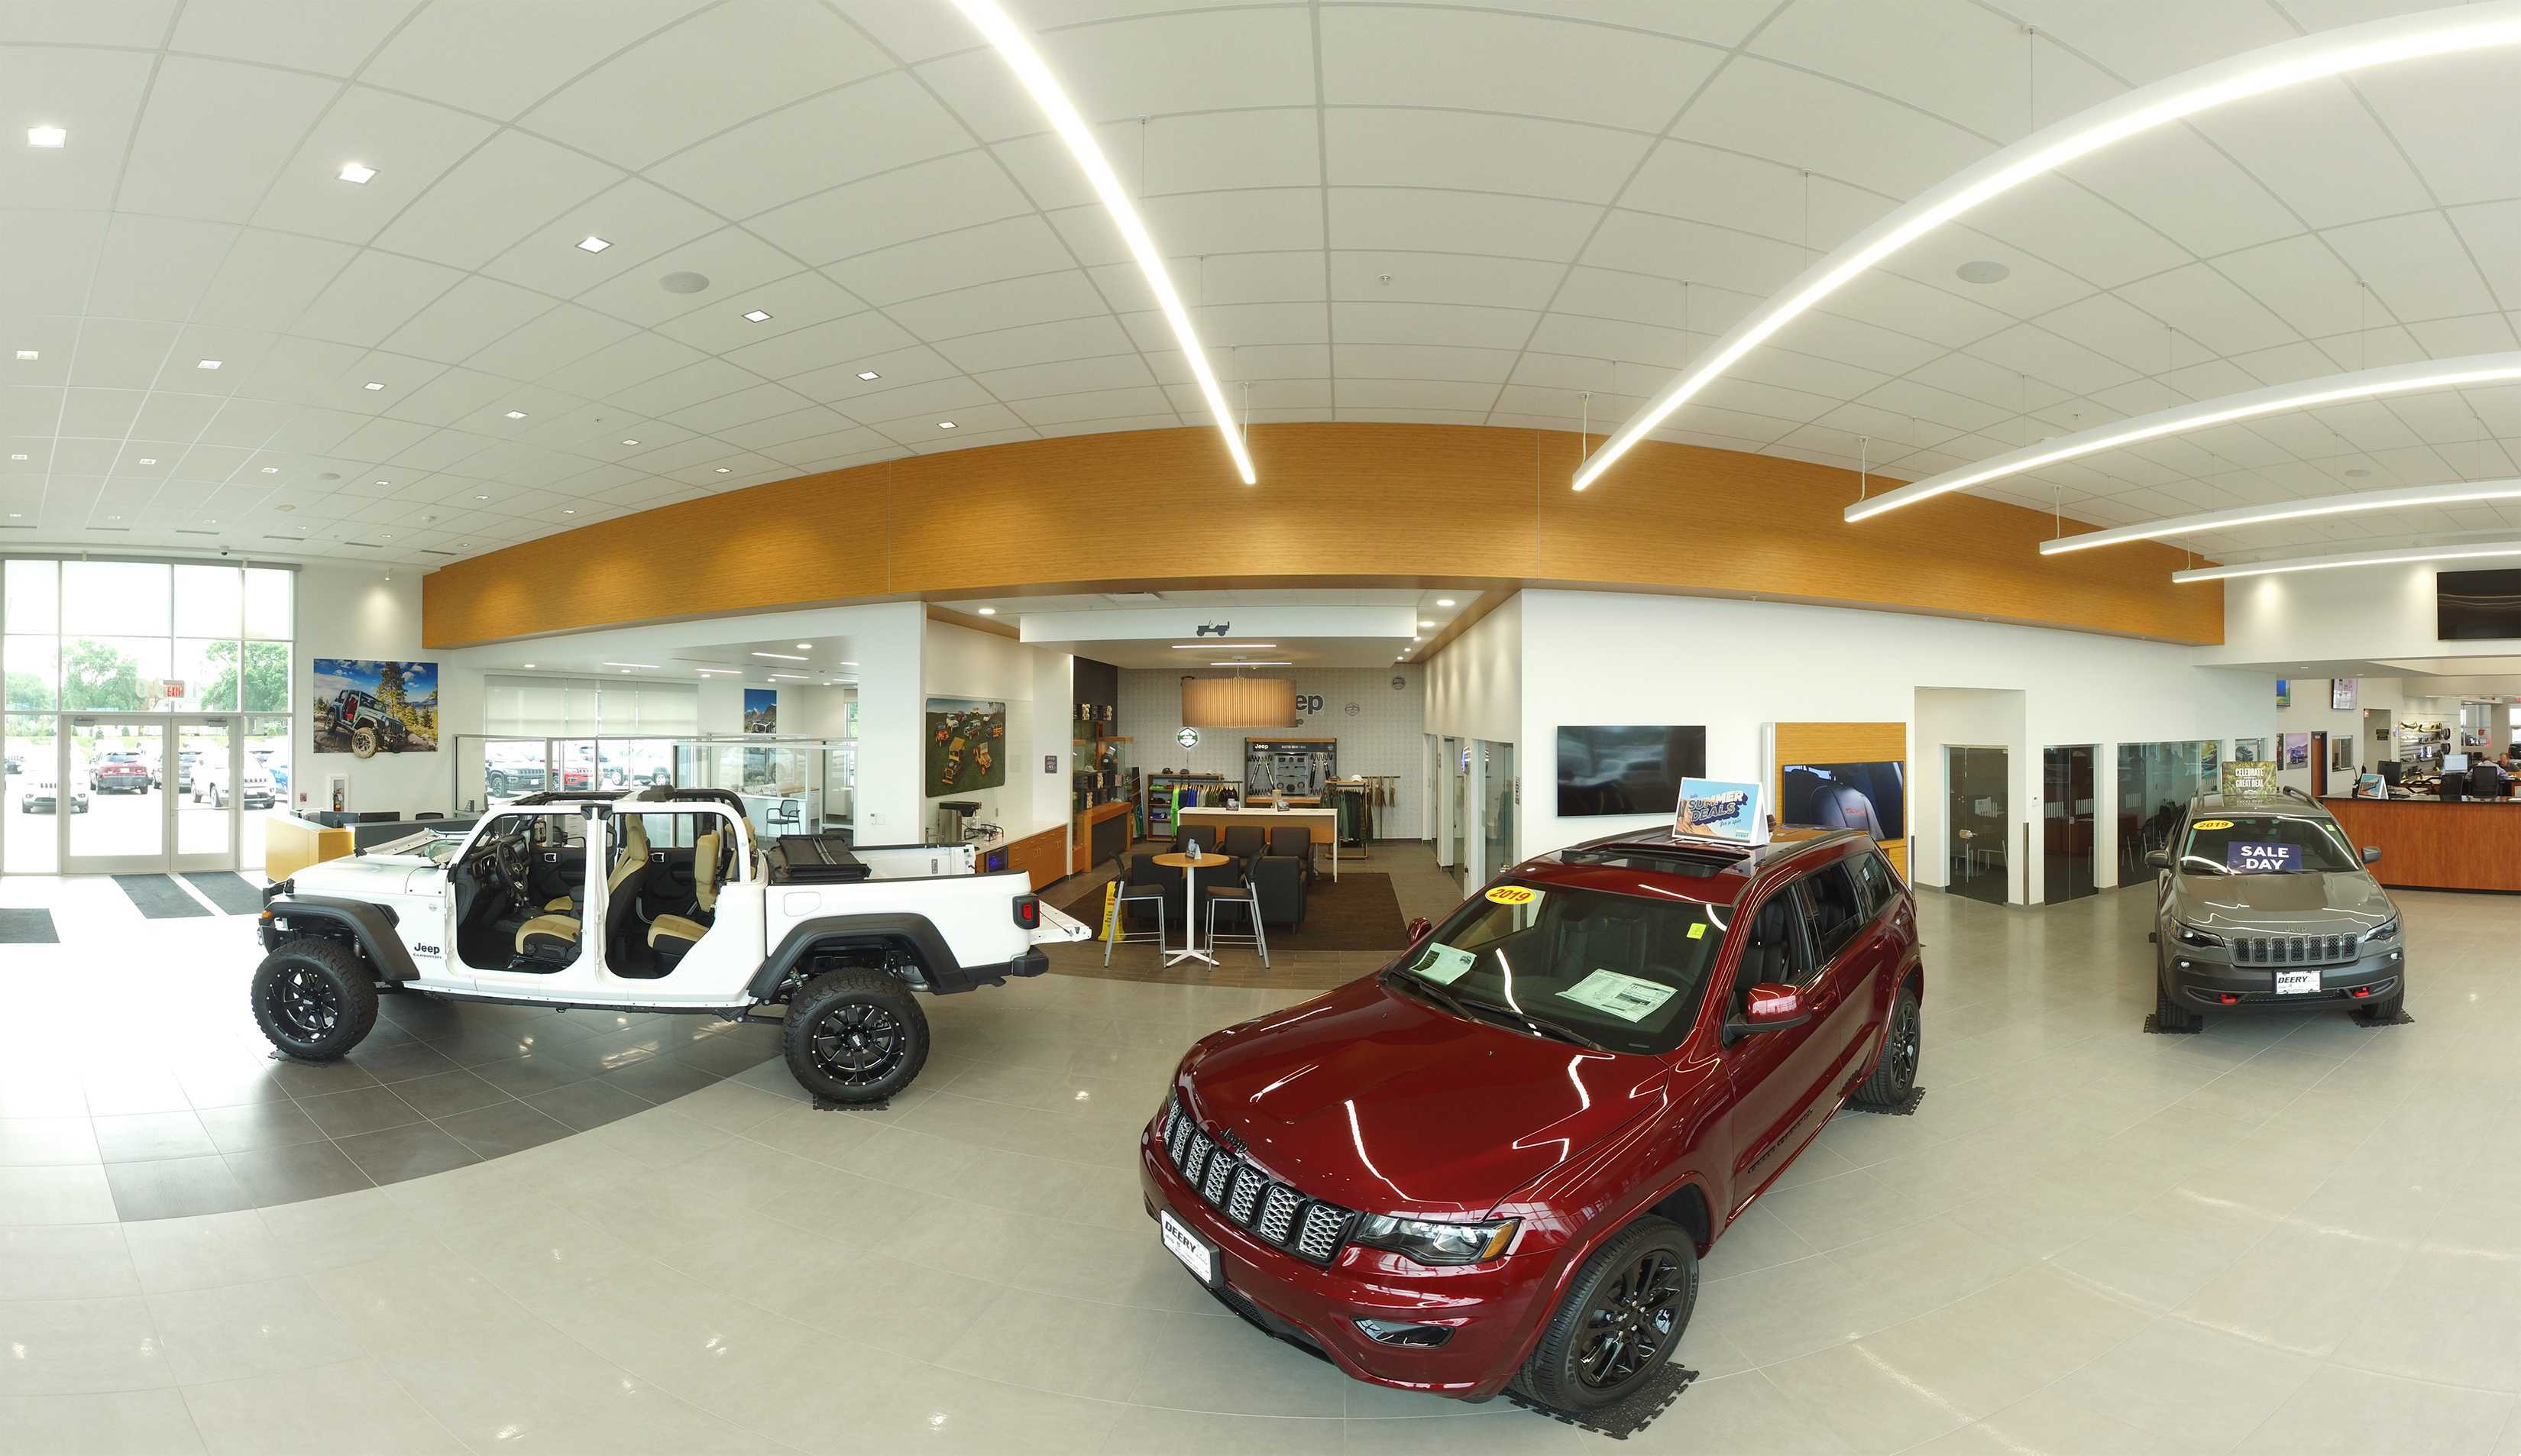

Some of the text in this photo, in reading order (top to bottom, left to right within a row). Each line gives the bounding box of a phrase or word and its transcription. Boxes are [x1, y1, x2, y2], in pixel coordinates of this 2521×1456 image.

[167, 684, 183, 697] EXIT
[1296, 694, 1323, 714] ep
[1688, 790, 1744, 811] SUMMER
[1691, 802, 1736, 823] DEALS
[2241, 846, 2290, 858] SALE
[2246, 859, 2284, 870] DAY
[1490, 888, 1531, 901] 2019
[414, 943, 440, 955] Jeep
[1165, 1221, 1197, 1254] DEERY
